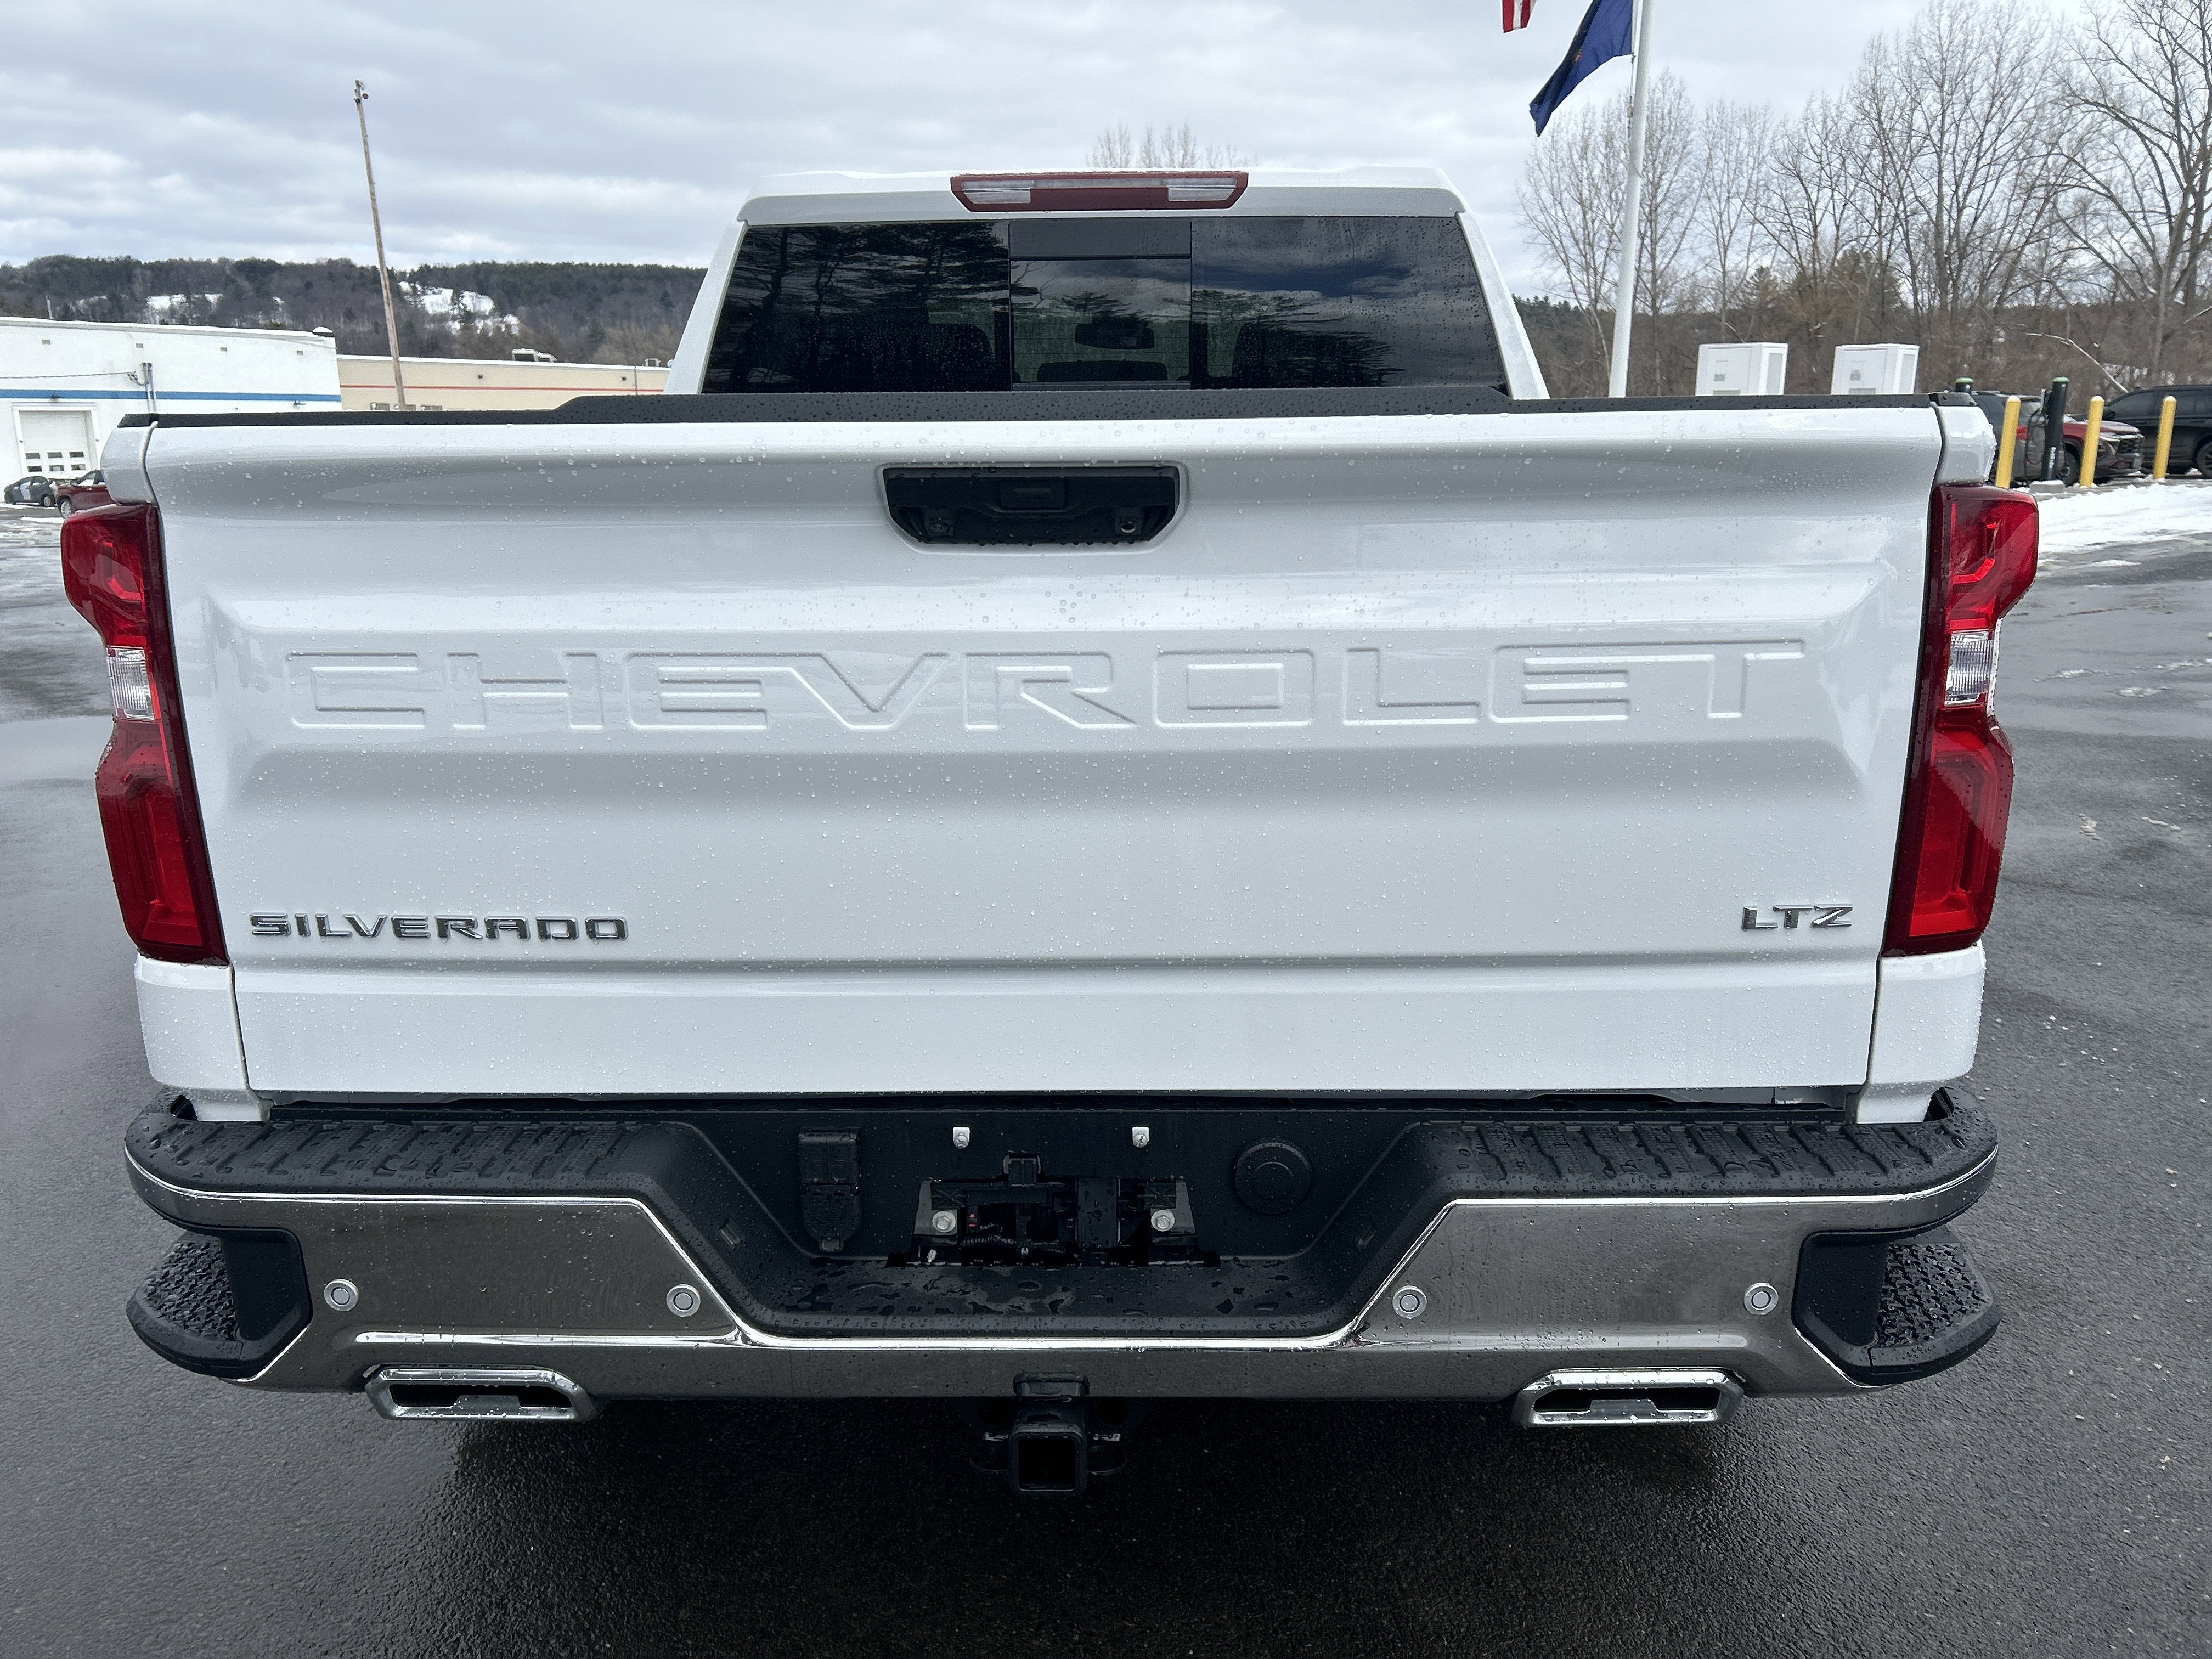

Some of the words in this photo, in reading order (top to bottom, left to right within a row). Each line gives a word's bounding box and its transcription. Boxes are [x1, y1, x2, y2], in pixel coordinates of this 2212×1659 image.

[285, 639, 1805, 732] CHEVROLET
[249, 912, 629, 941] SILVERADO
[1741, 904, 1853, 930] LTZ
